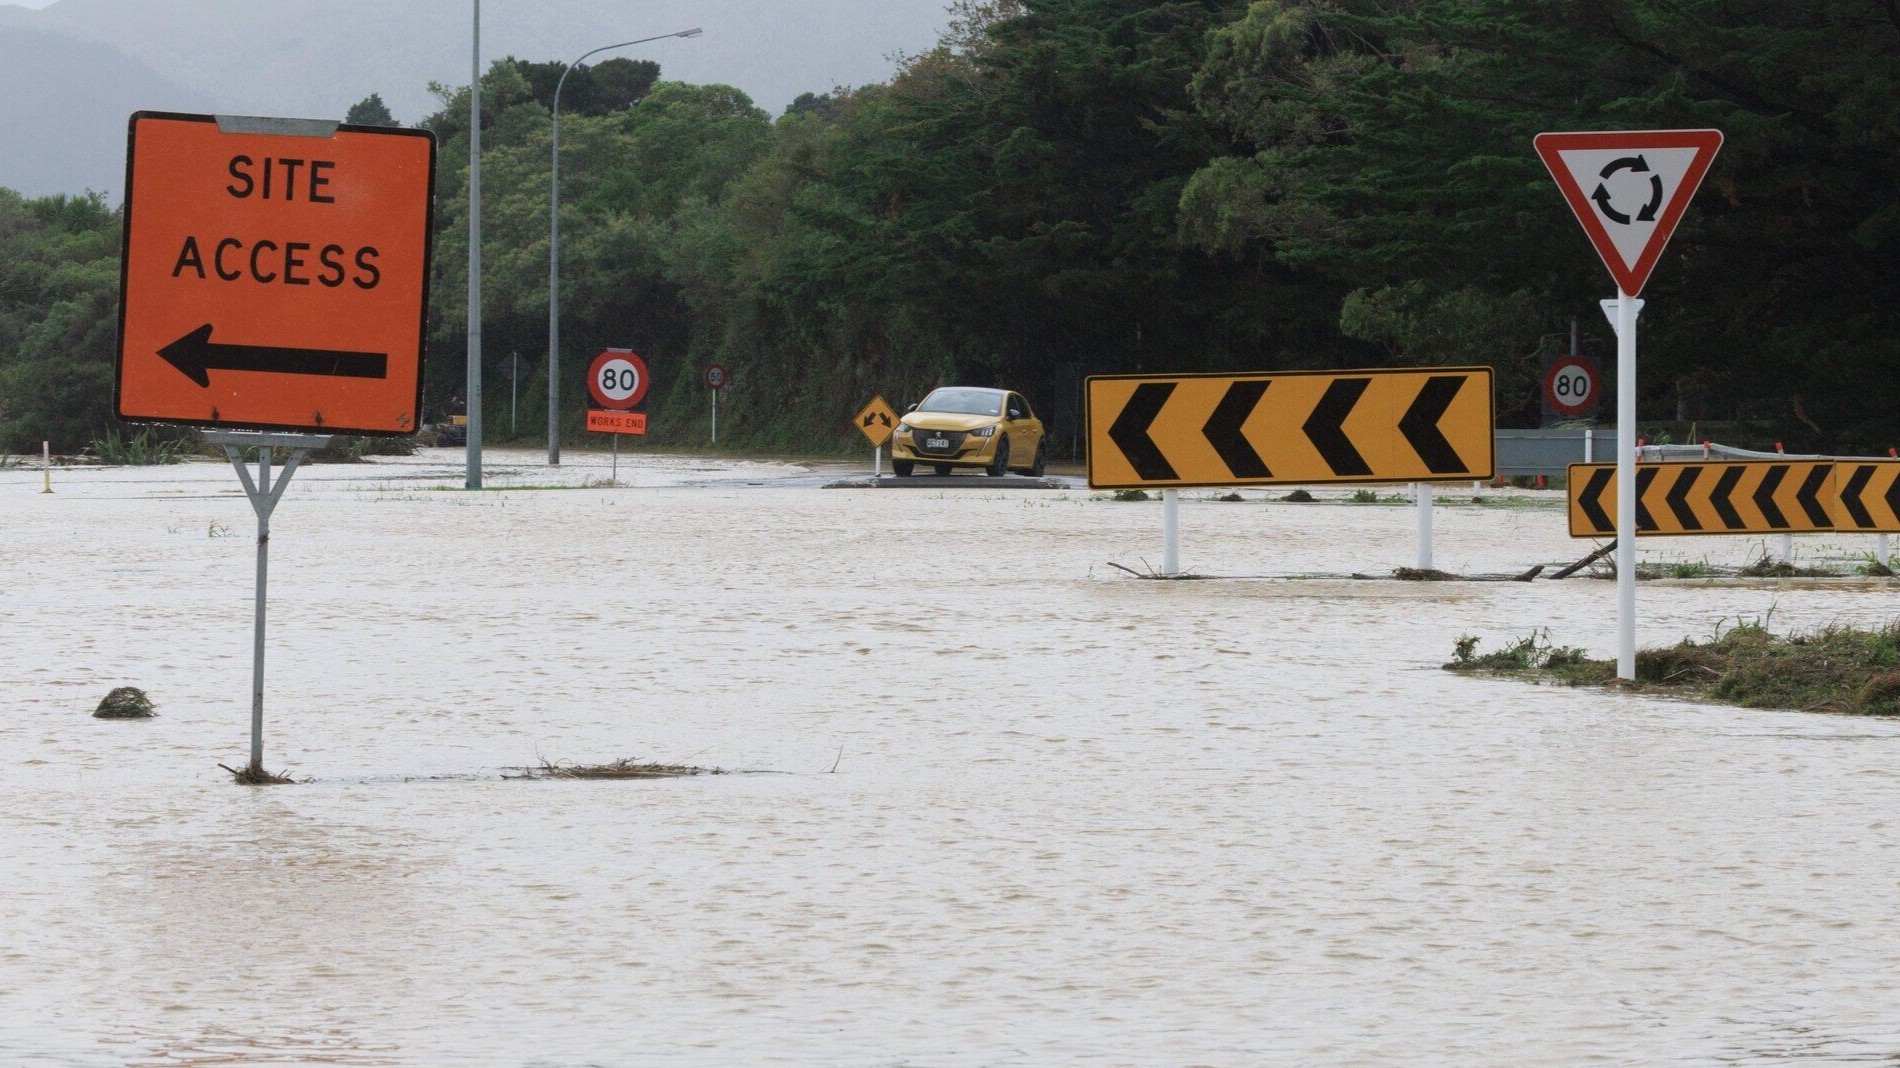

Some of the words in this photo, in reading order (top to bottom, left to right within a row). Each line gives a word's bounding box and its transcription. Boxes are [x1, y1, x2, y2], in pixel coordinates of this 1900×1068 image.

[226, 155, 335, 204] SITE
[171, 236, 381, 290] ACCESS
[602, 368, 635, 391] 80
[1556, 374, 1588, 397] 80
[590, 416, 622, 428] WORKS
[626, 418, 644, 429] END
